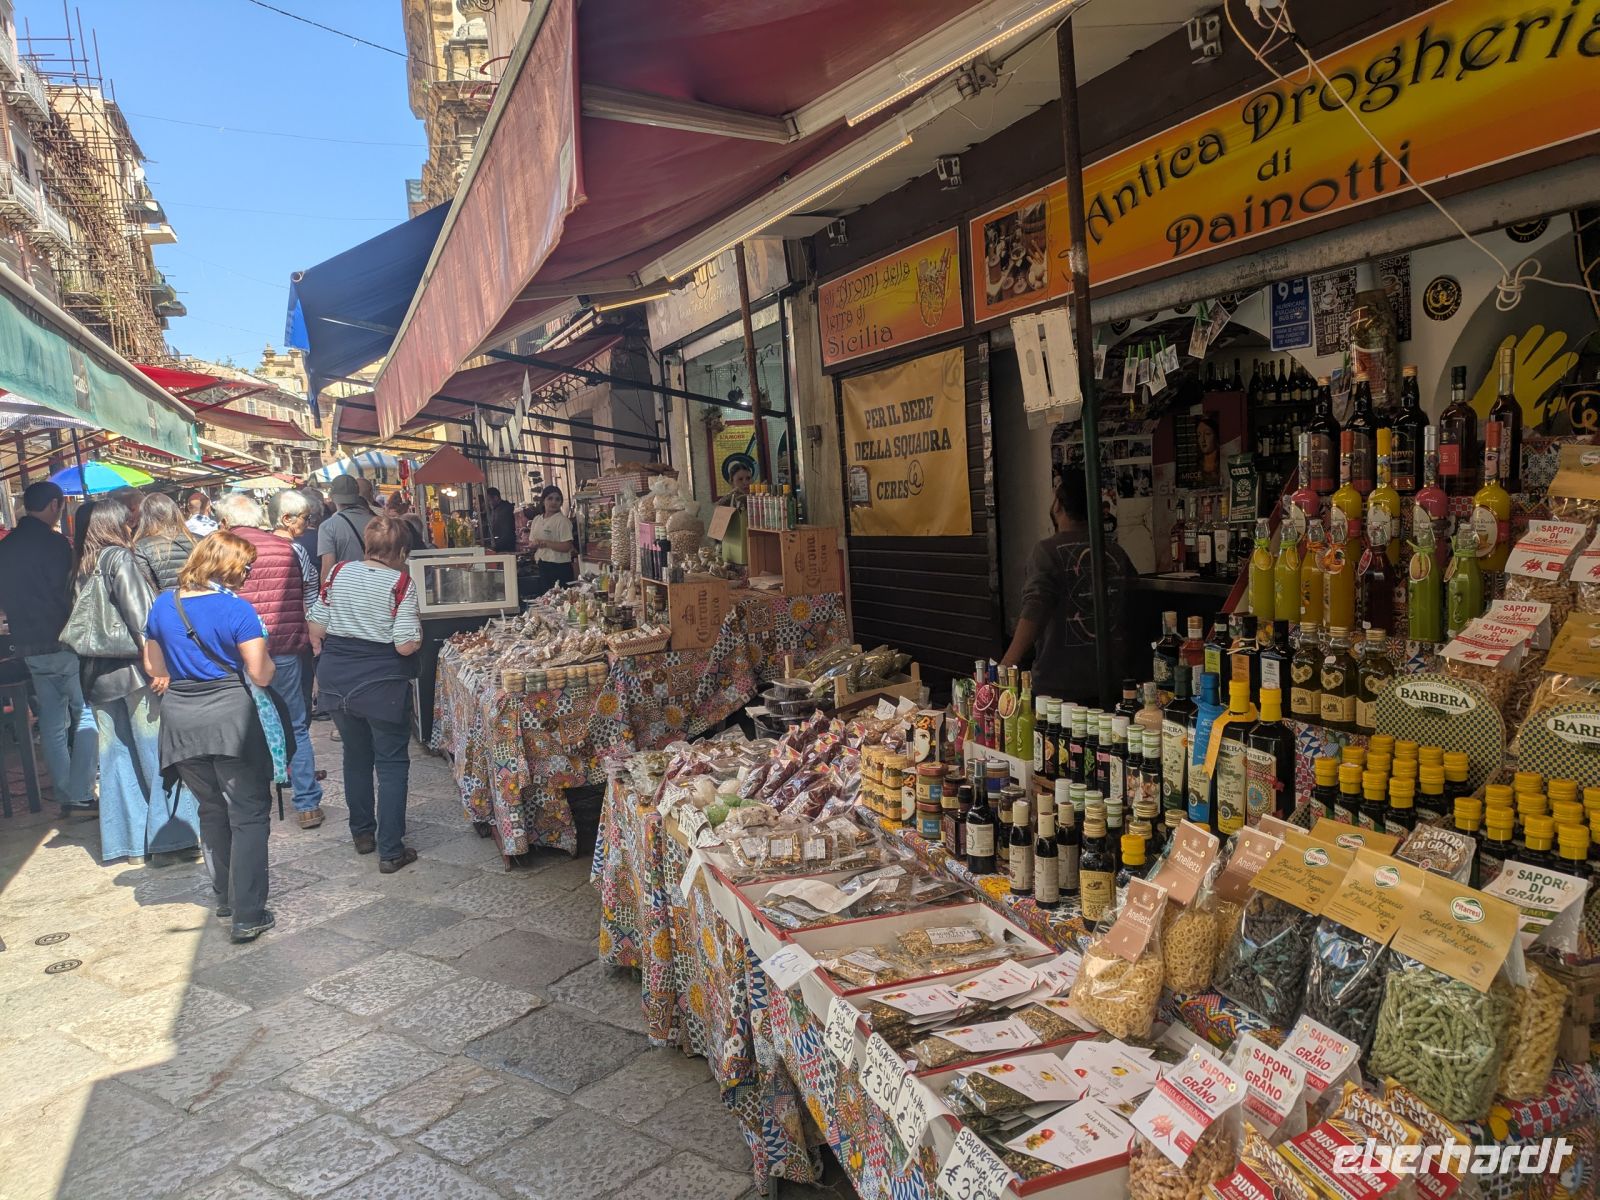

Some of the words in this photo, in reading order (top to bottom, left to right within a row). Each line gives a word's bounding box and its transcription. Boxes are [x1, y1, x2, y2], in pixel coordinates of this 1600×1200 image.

[1085, 132, 1225, 245] Antica
[1242, 0, 1600, 143] Drogheria
[1257, 147, 1292, 181] di
[1166, 141, 1412, 257] Dainotti
[837, 266, 879, 304] Aromi
[883, 260, 911, 283] della
[857, 303, 866, 321] di
[828, 325, 894, 357] Sicilia
[864, 407, 887, 429] PER
[887, 404, 900, 425] IL
[900, 396, 934, 423] BERE
[854, 438, 893, 461] DELLA
[894, 427, 952, 460] SQUADRA
[876, 479, 909, 500] CERES
[1541, 524, 1574, 535] SAPORI
[1503, 604, 1538, 614] SAPORI
[1400, 687, 1471, 709] BARBERA
[1412, 840, 1427, 850] DI
[1422, 829, 1466, 850] SAPORI
[1427, 839, 1460, 863] GRANO
[1174, 850, 1202, 874] Anelletti
[1517, 869, 1567, 891] SAPORI
[1529, 884, 1544, 895] DI
[1505, 887, 1555, 905] GRANO
[1454, 902, 1481, 918] Pitarresi
[1308, 1027, 1344, 1055] SAPORI
[1314, 1044, 1327, 1057] DI
[1252, 1048, 1293, 1080] SAPORI
[1295, 1046, 1331, 1071] GRANO
[1201, 1076, 1216, 1090] DI
[1244, 1070, 1283, 1102] GRANO
[1261, 1067, 1274, 1082] DI
[1181, 1075, 1217, 1104] GRANO
[1343, 1107, 1362, 1121] DI
[1352, 1093, 1409, 1146] SAPORI
